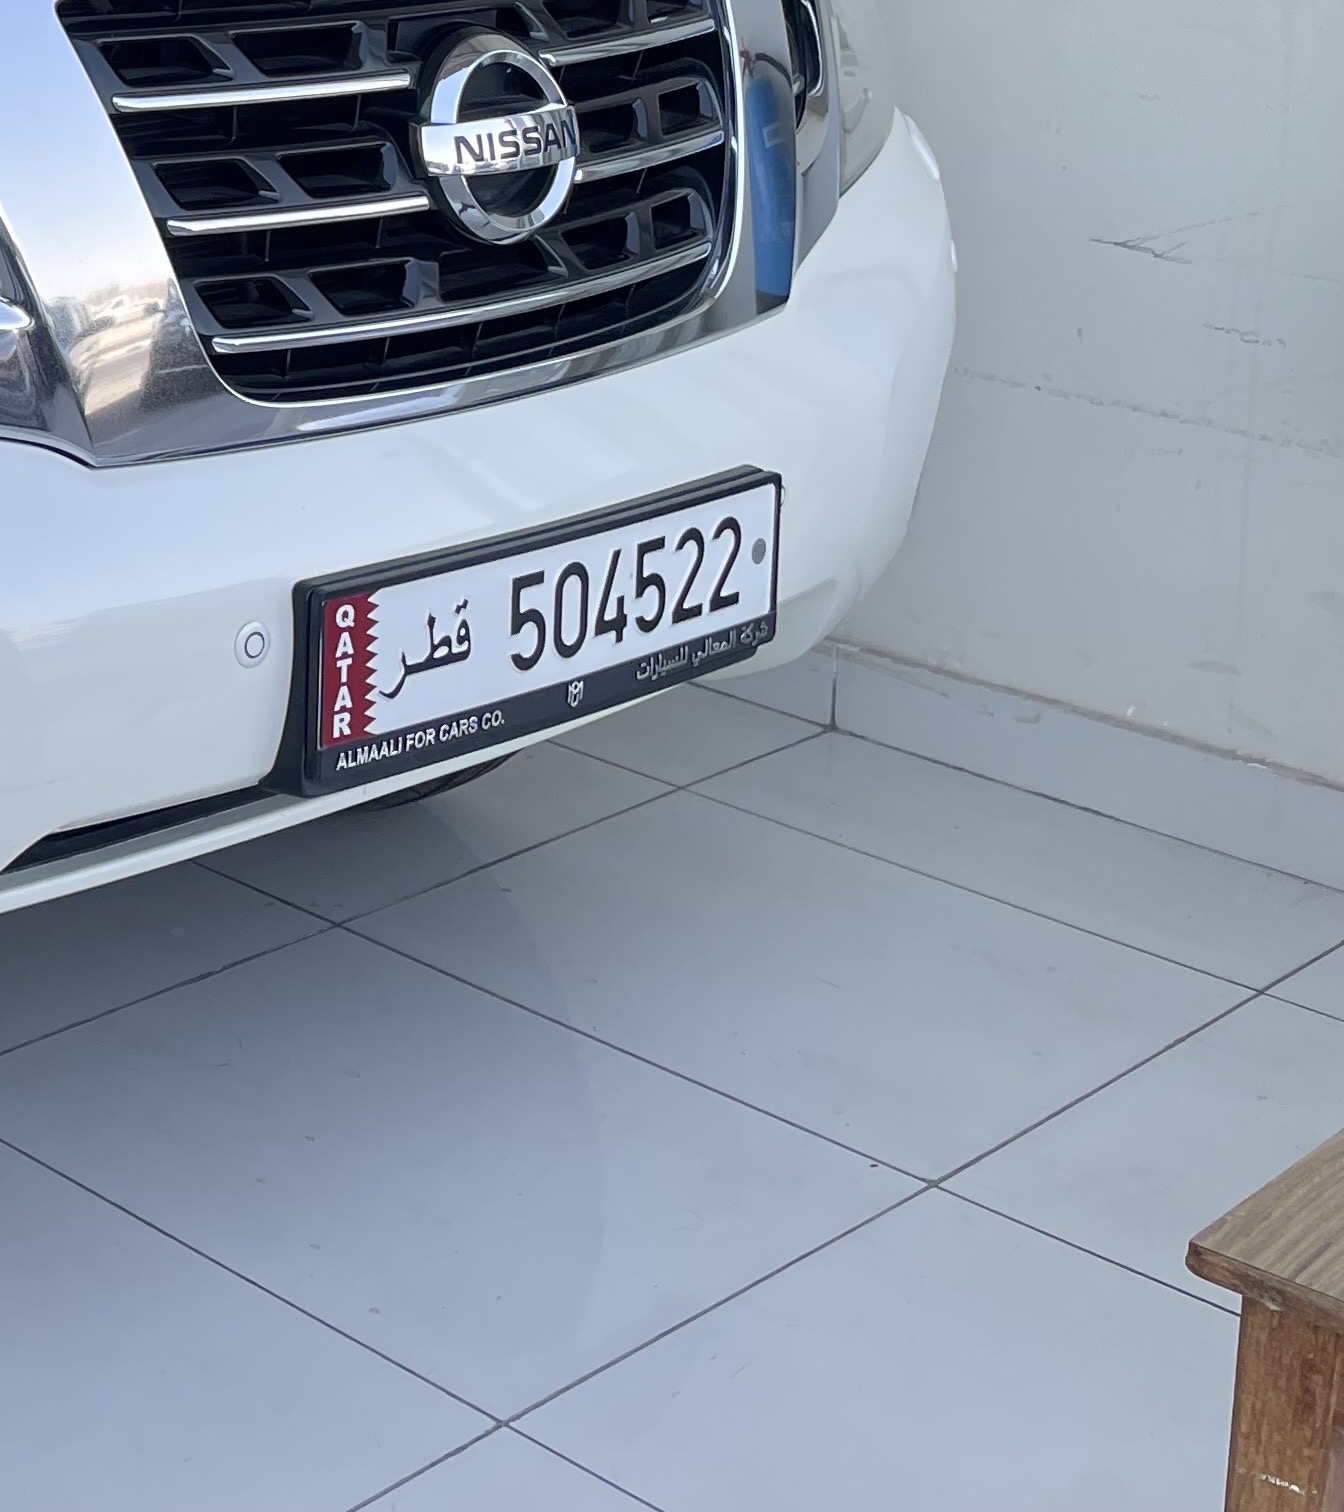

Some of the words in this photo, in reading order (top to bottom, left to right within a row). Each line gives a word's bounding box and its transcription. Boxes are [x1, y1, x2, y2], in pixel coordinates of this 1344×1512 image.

[453, 119, 577, 164] NISSAN
[510, 516, 742, 672] 504522
[378, 598, 472, 700] قطر
[691, 628, 737, 668] المعالي
[739, 619, 769, 647] شركة
[332, 604, 356, 739] QATAR
[635, 645, 689, 682] للسيارات
[335, 736, 403, 772] ALMAALI
[405, 727, 436, 753] FOR
[438, 715, 479, 743] CARS
[481, 709, 505, 730] CO.
